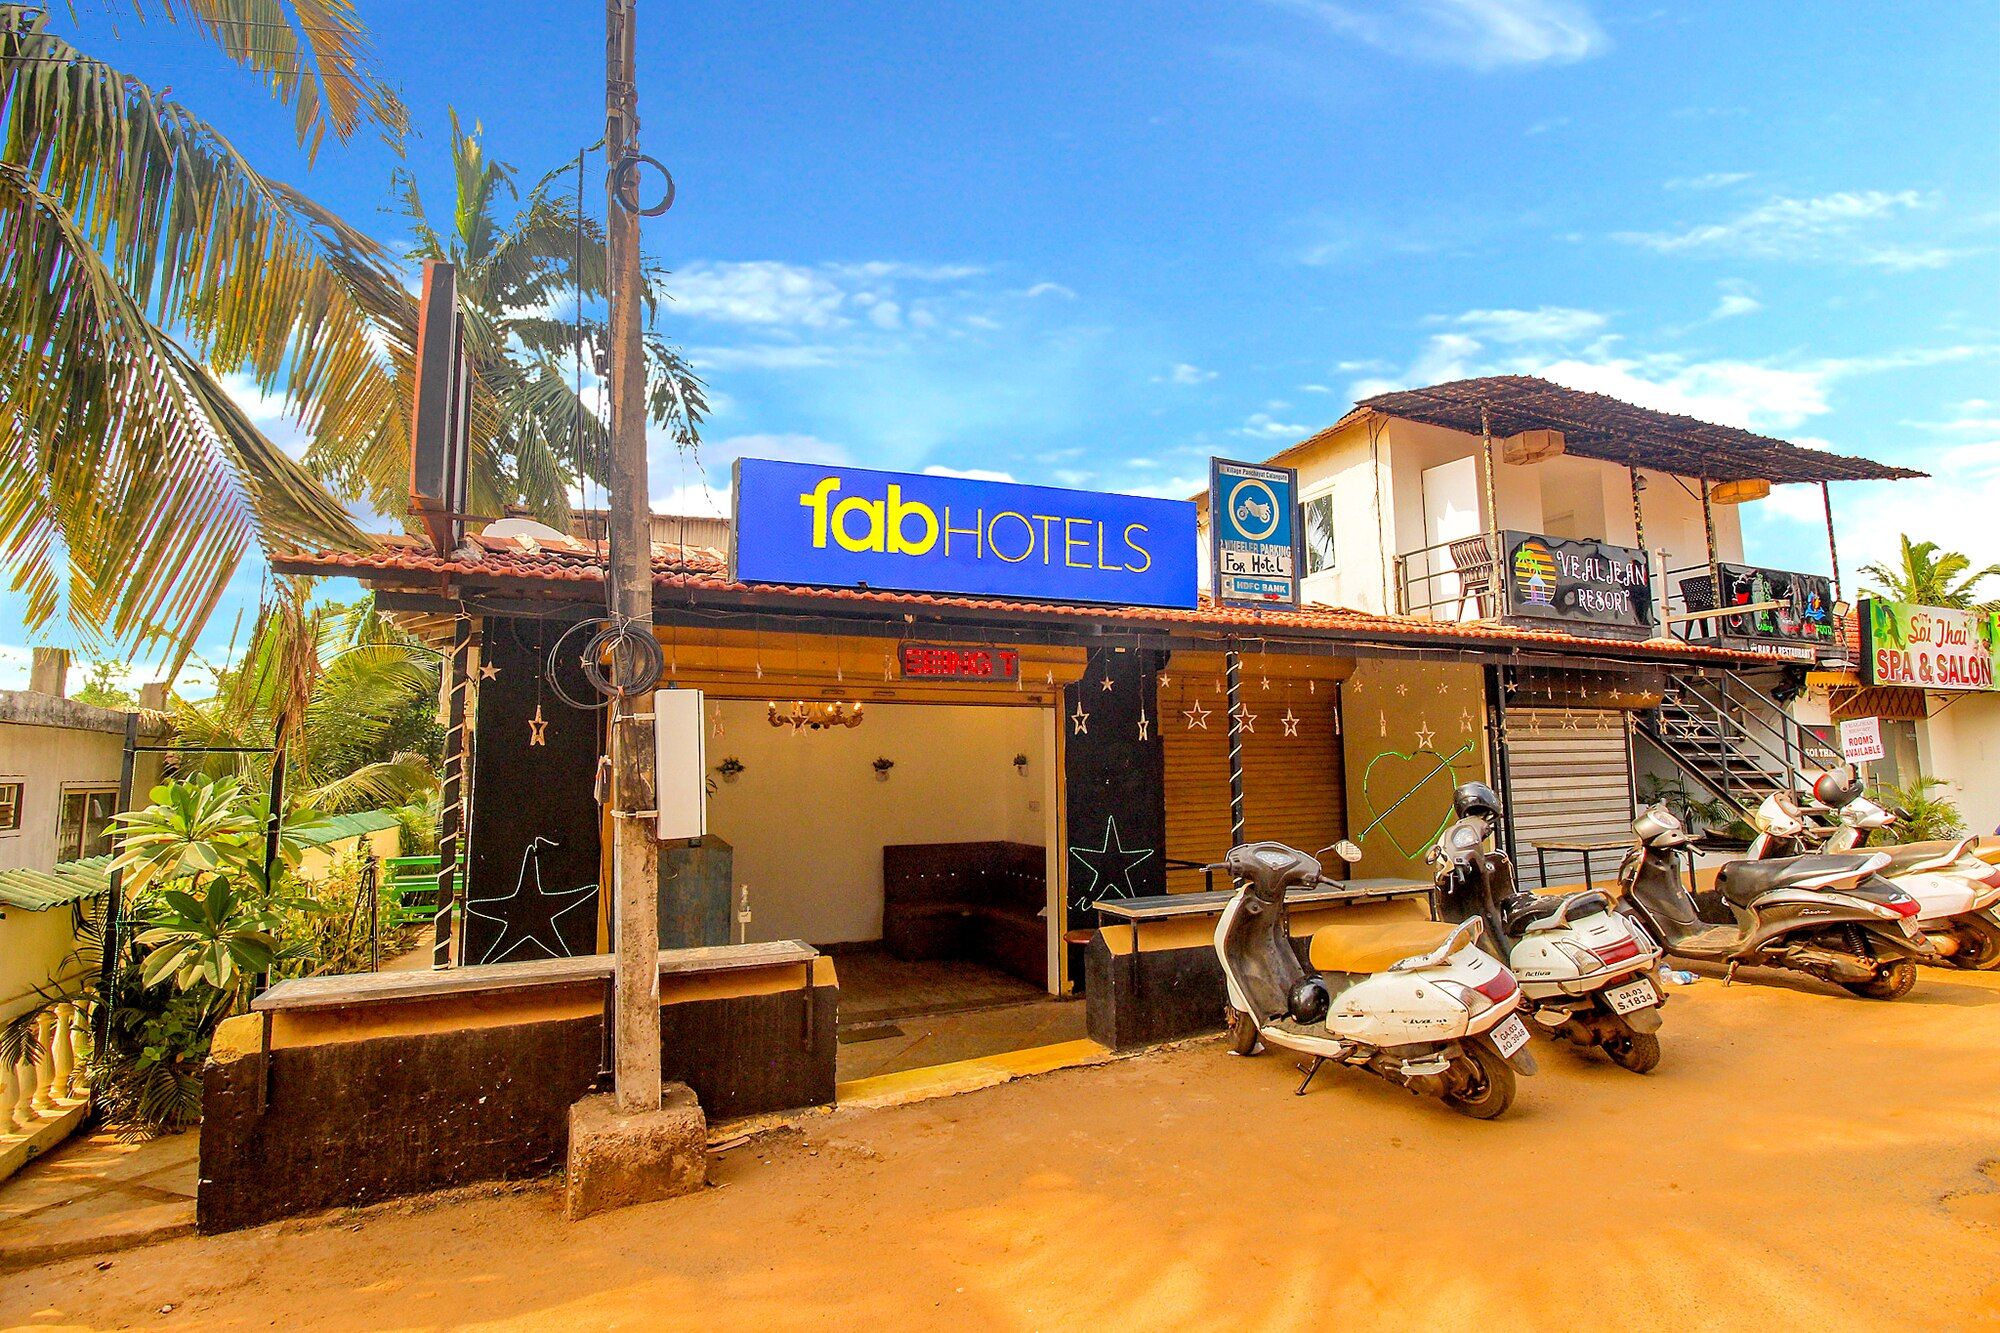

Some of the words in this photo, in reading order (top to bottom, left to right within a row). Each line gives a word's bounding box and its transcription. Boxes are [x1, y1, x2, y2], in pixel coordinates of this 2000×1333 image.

[1236, 581, 1260, 591] HDFC
[1261, 583, 1287, 594] BANK
[1577, 588, 1631, 616] RESORT
[1935, 618, 1967, 648] Thai
[1877, 648, 1914, 681] SPA
[1918, 652, 1933, 683] &
[1935, 653, 1993, 685] SALON
[1848, 735, 1874, 746] ROOMS
[1845, 745, 1881, 757] AVAILABLE
